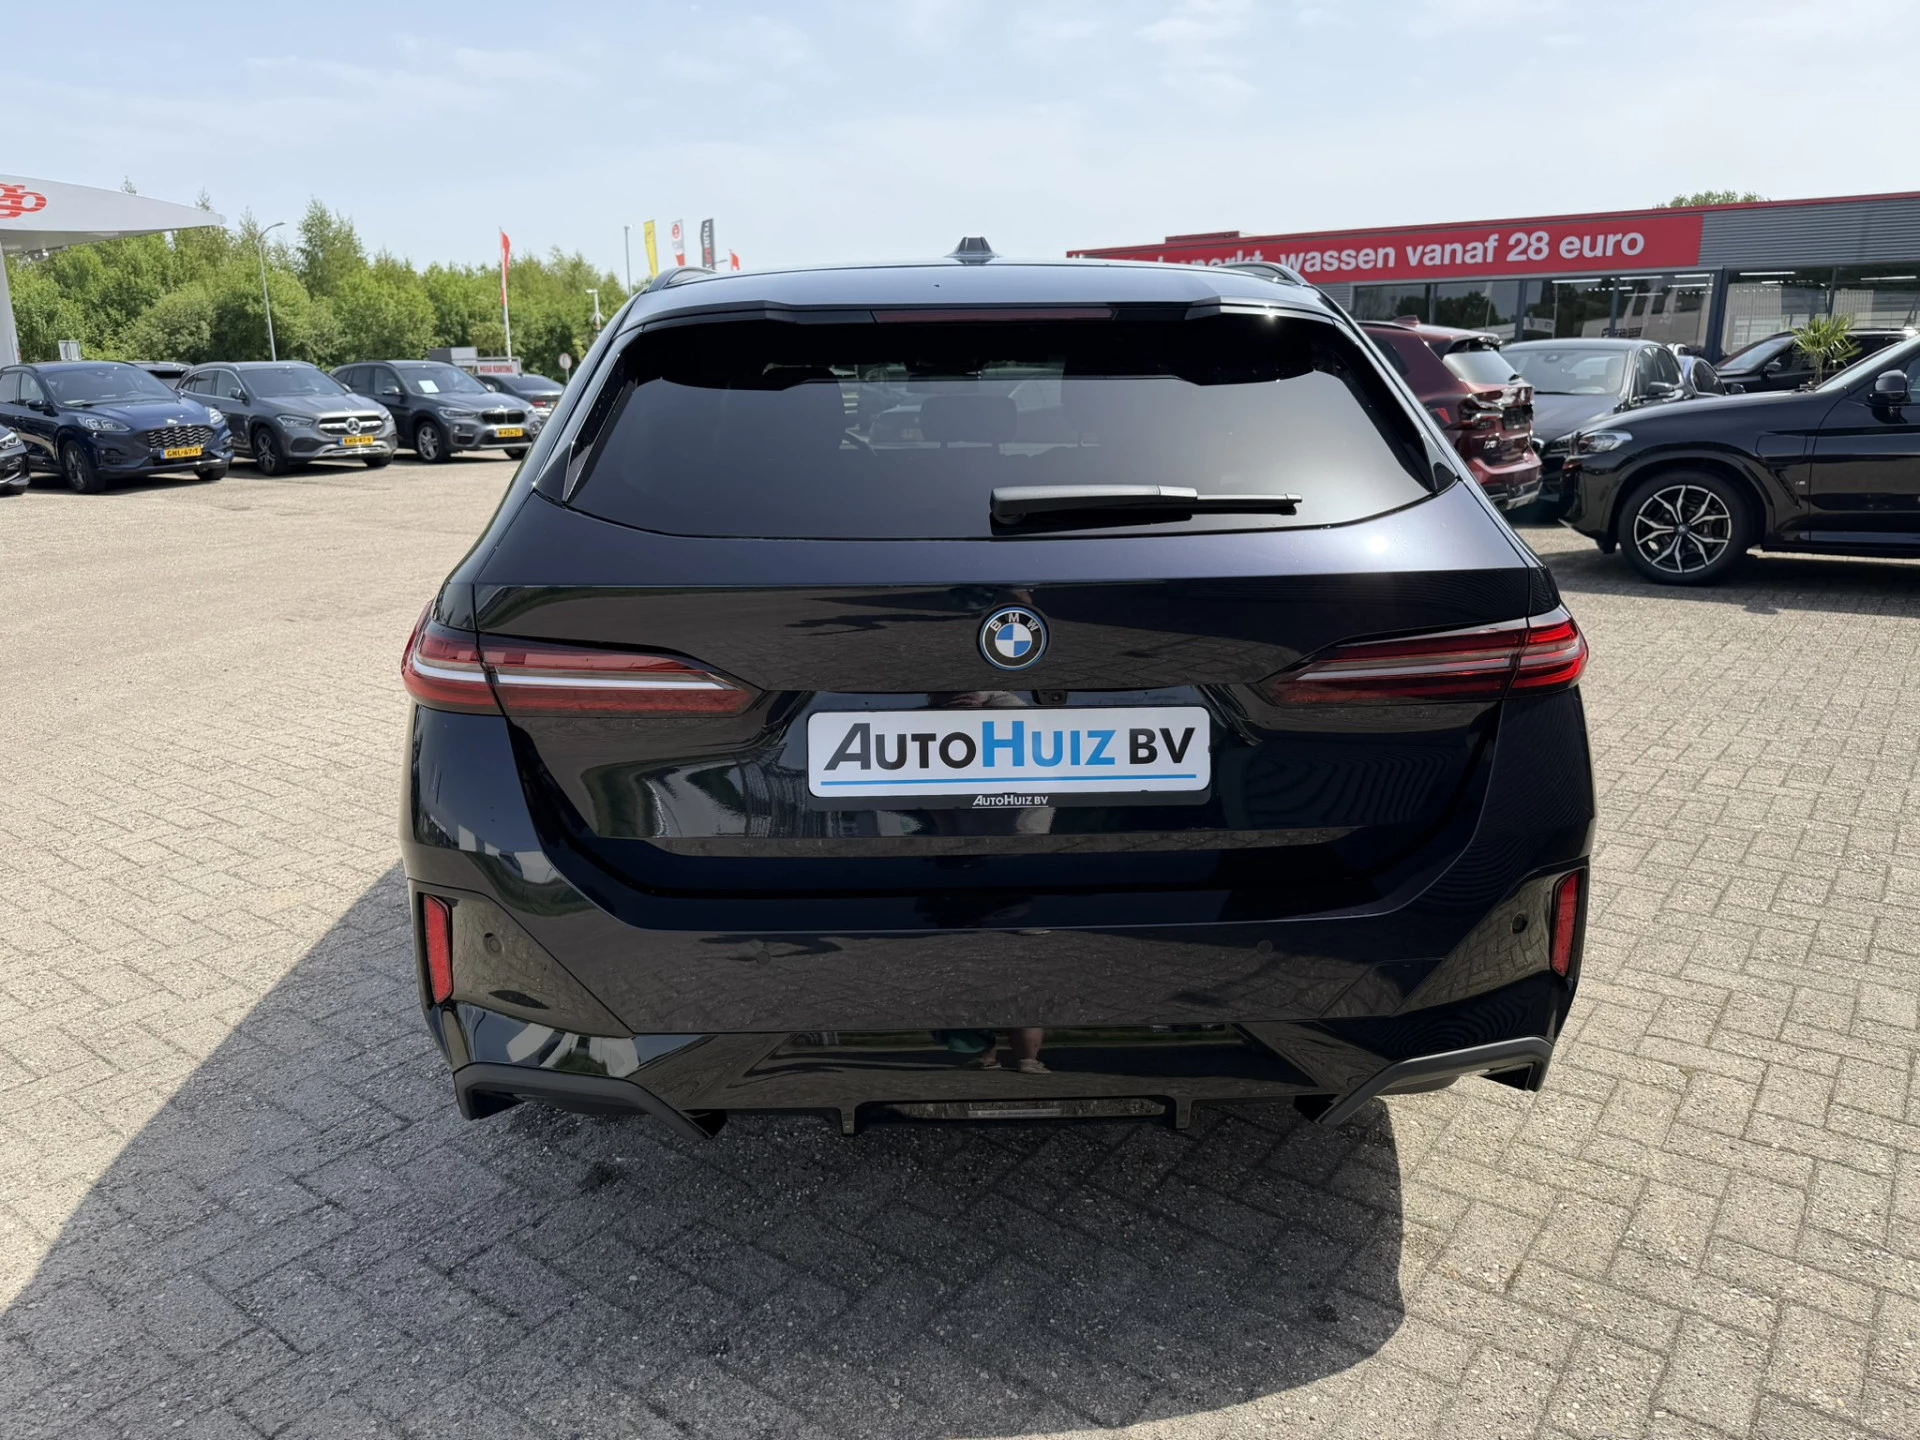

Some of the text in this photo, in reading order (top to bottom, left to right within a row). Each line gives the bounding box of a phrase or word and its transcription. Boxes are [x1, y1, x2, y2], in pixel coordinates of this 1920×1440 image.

[1280, 246, 1396, 273] wassen
[1405, 234, 1499, 267] vanaf
[1506, 231, 1550, 262] 28
[1559, 231, 1645, 260] euro
[990, 612, 1039, 632] BMW
[823, 720, 1196, 771] AUTOHUIZ BV
[972, 794, 1049, 806] AUTOHUIZ BV
